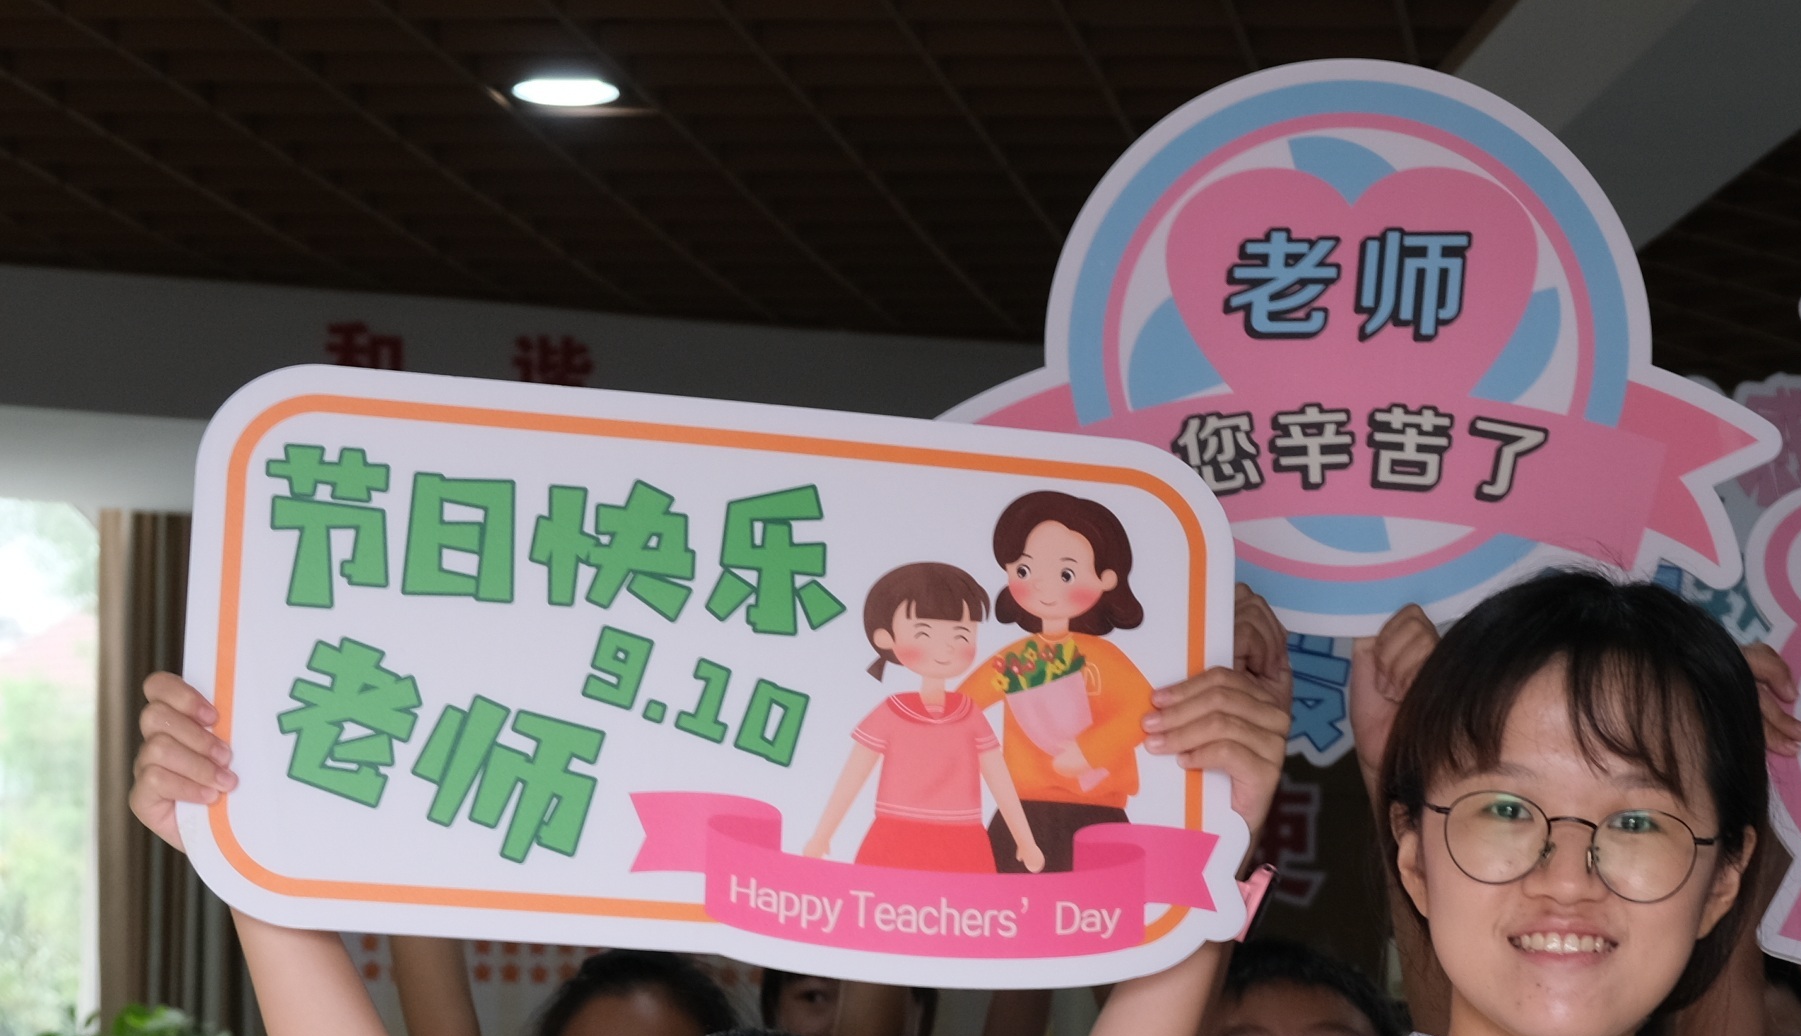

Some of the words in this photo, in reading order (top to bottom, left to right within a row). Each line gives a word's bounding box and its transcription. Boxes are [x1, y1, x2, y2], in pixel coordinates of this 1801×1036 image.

[1224, 228, 1472, 340] 老师
[1171, 402, 1550, 502] 您辛苦了
[266, 443, 846, 636] 节日快乐
[278, 637, 606, 863] 老师
[582, 626, 809, 767] 9.10
[729, 874, 842, 933] Happy
[1055, 901, 1121, 939] Day
